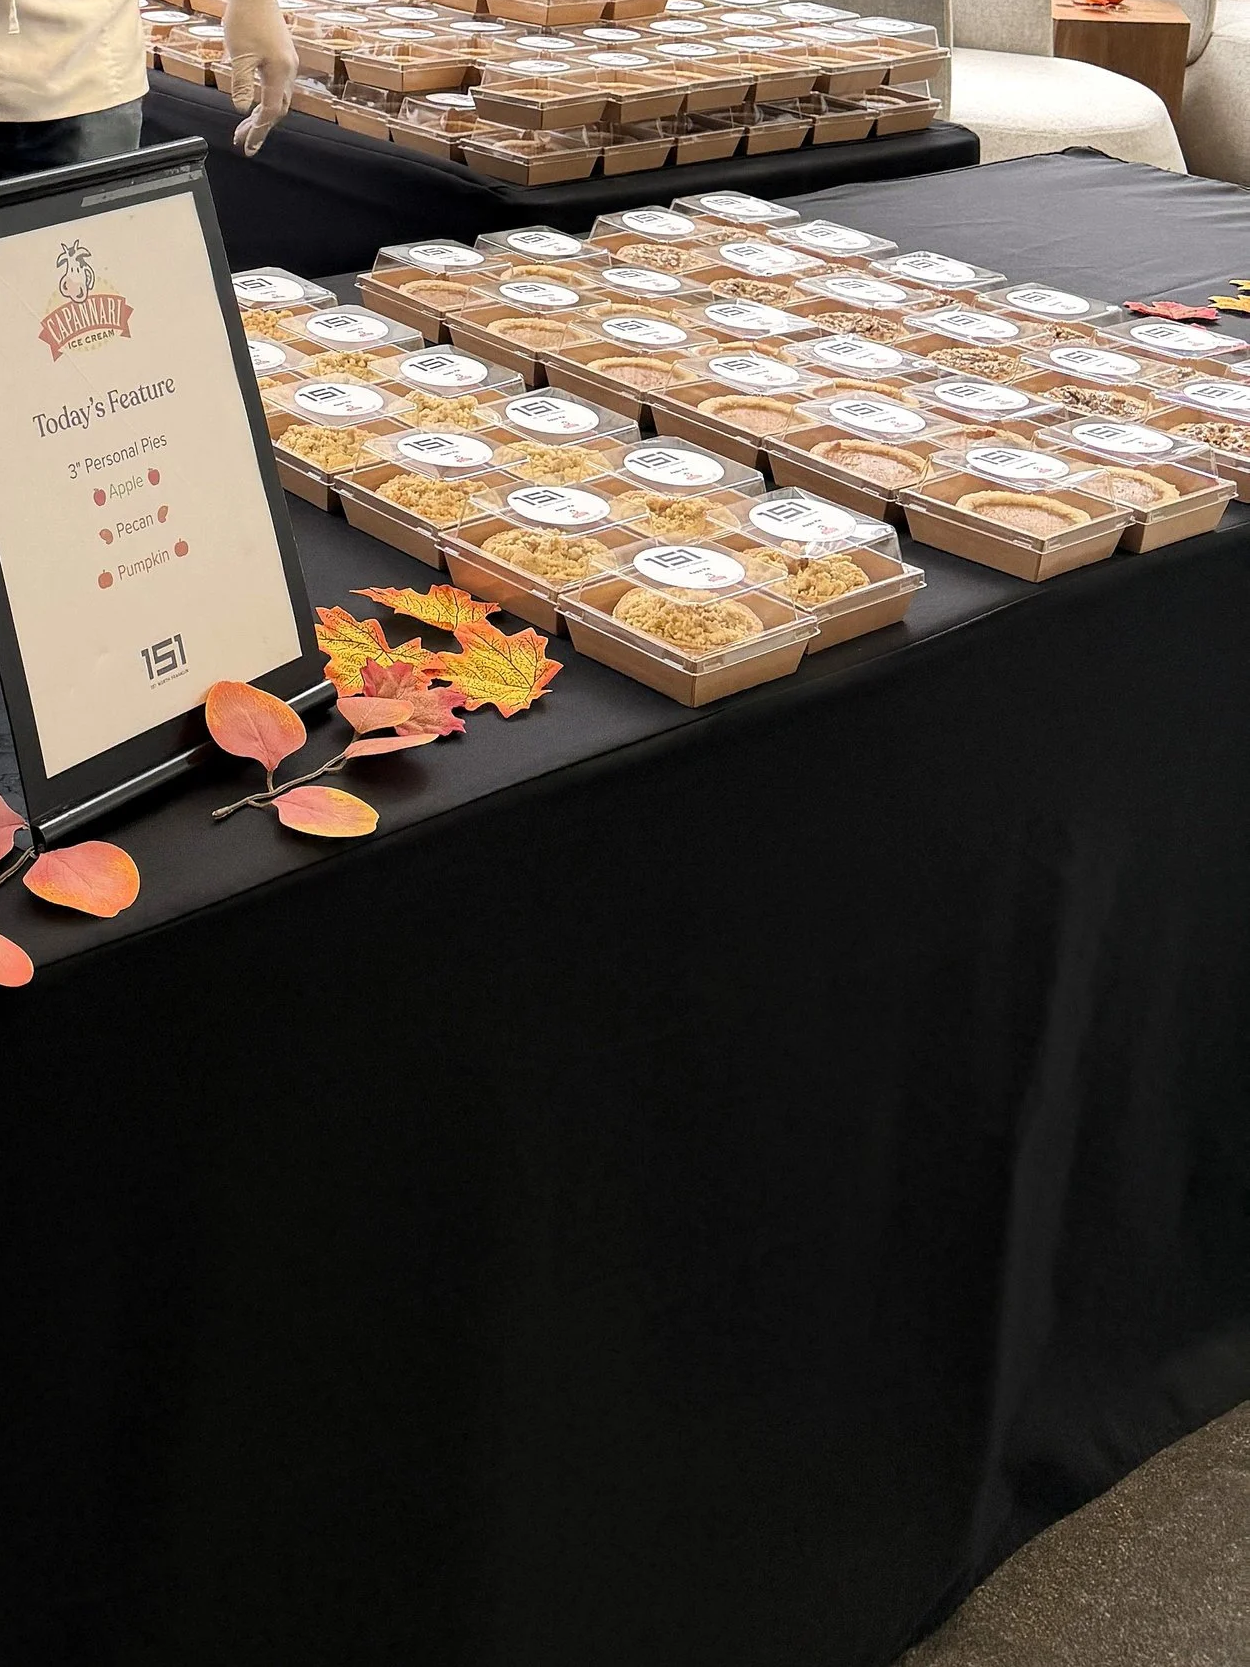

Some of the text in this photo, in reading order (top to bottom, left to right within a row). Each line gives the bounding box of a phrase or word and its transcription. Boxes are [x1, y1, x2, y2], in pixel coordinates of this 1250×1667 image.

[47, 297, 122, 344] CAPANNARI
[315, 315, 358, 329] 151
[68, 329, 115, 349] ICE CREAM
[409, 356, 454, 372] 151
[107, 378, 176, 414] Feature
[299, 387, 346, 402] 151
[511, 401, 560, 416] 151
[404, 437, 454, 451] 151
[84, 441, 139, 474] Personal
[141, 434, 168, 453] Pies
[628, 451, 679, 468] 151
[109, 475, 144, 499] Apple
[512, 489, 565, 506] 151
[756, 502, 812, 521] 151
[116, 514, 154, 538] Pecan
[117, 549, 170, 580] Pumpkin
[644, 549, 702, 568] 151
[141, 633, 187, 681] 151
